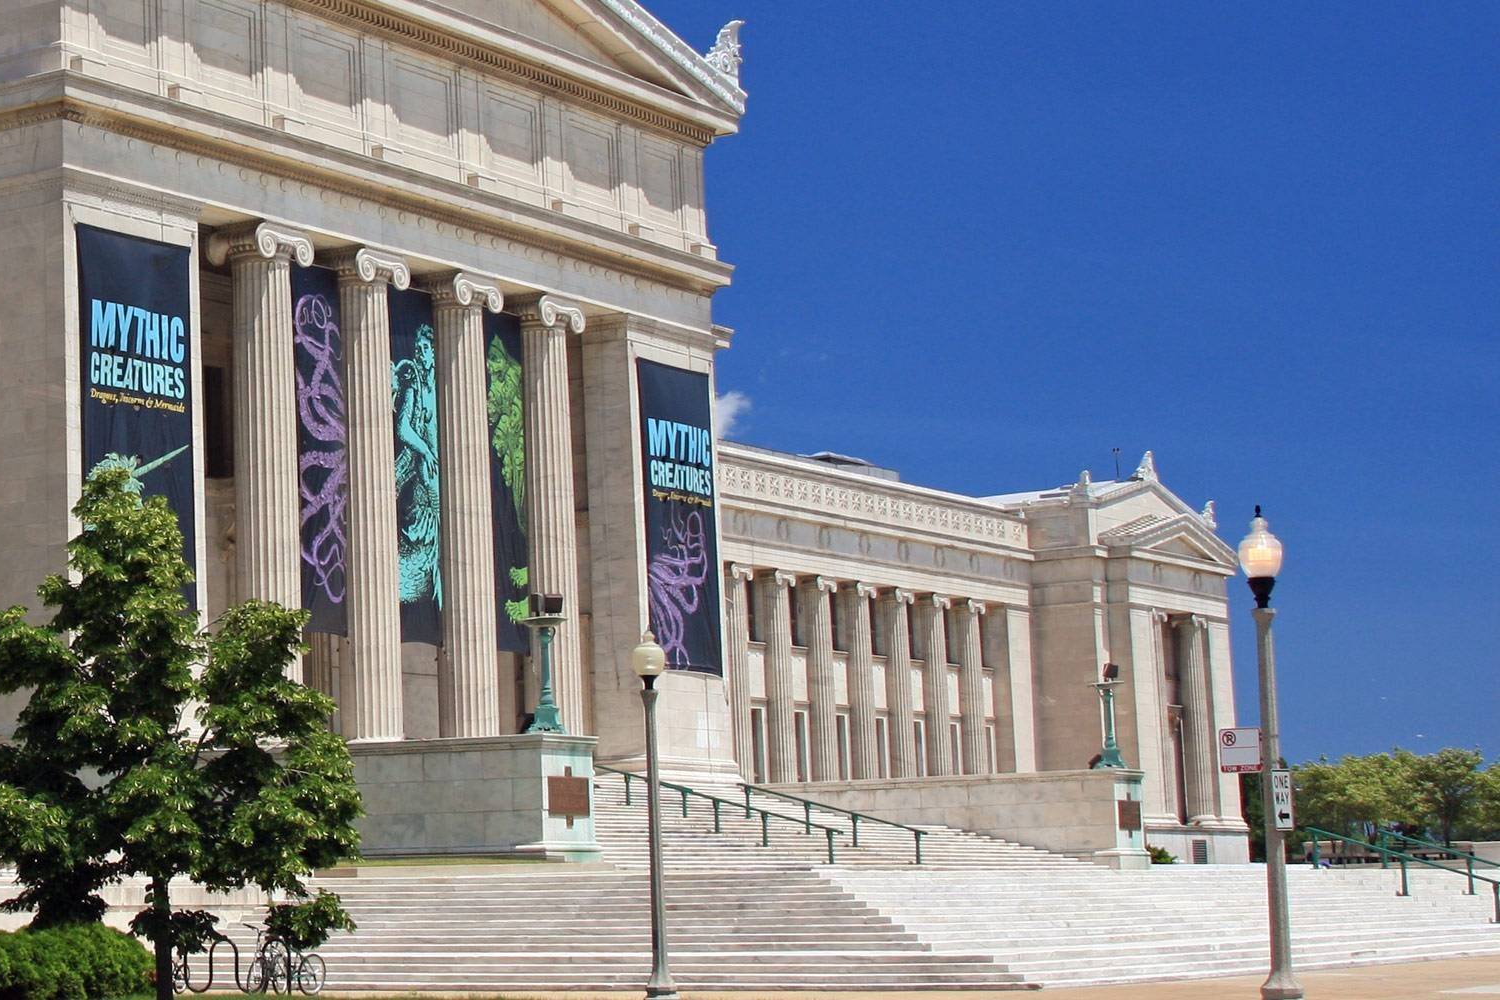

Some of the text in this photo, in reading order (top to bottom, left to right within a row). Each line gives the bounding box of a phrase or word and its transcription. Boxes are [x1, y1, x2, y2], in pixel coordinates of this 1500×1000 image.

[91, 299, 185, 363] MYTHIC
[90, 351, 185, 399] CREATURES
[145, 397, 154, 408] &
[154, 399, 185, 413] Mermaids
[648, 417, 710, 467] MYTHIC
[651, 459, 711, 496] CREATURES
[1273, 775, 1289, 789] ONE
[1275, 791, 1290, 805] WAY
